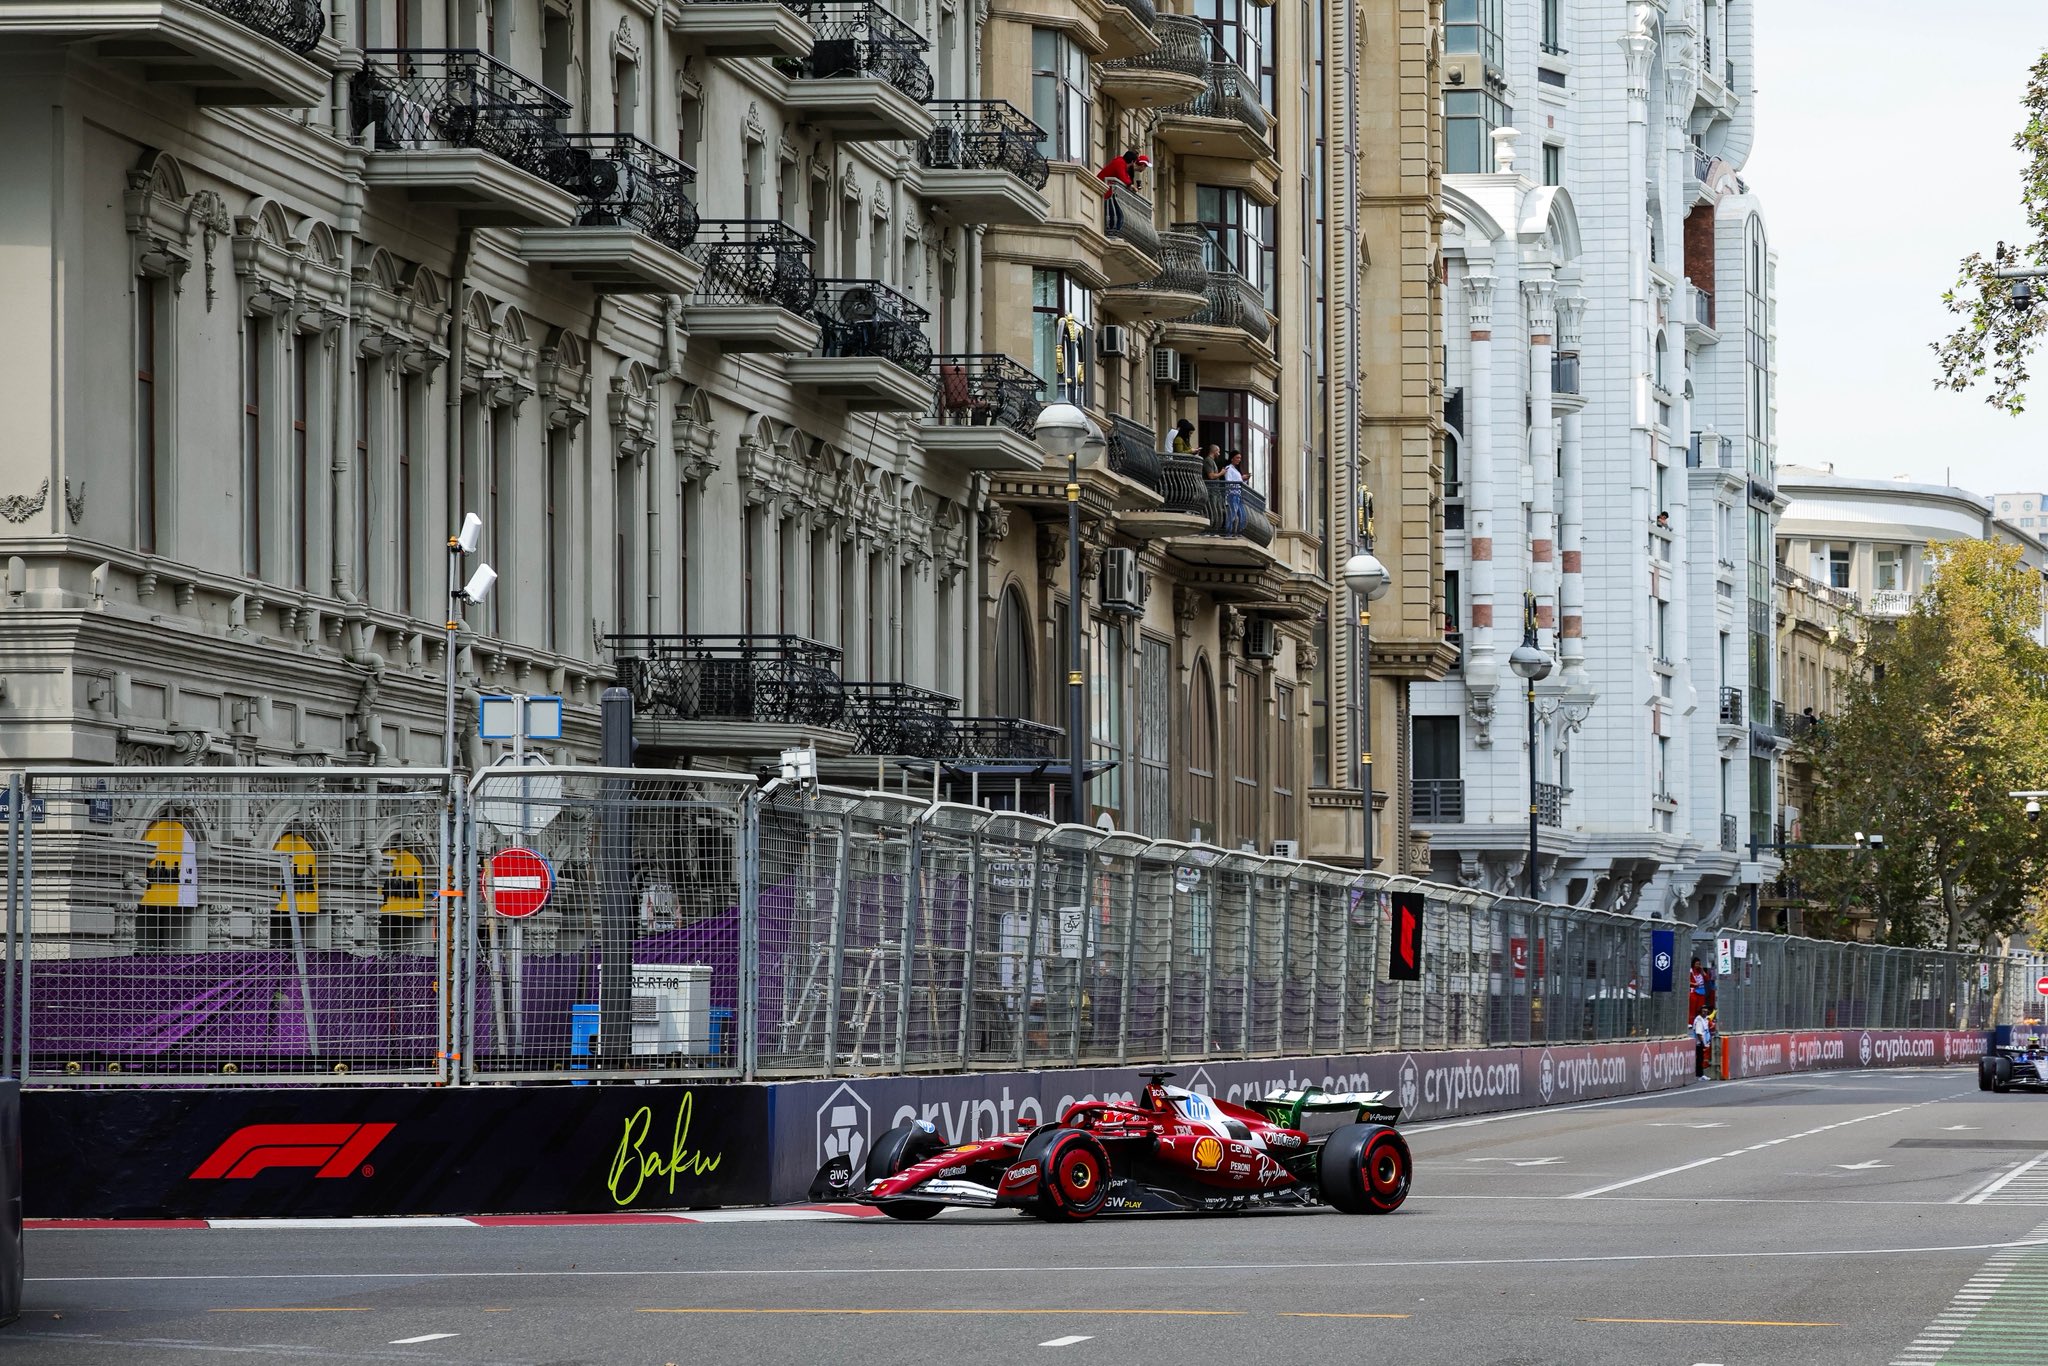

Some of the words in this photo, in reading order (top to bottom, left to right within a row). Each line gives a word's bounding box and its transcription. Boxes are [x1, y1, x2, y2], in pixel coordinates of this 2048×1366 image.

[1798, 1037, 1844, 1066] crypto.com
[1875, 1035, 1935, 1062] crypto.com
[1425, 1058, 1520, 1110] crypto.com
[1557, 1052, 1627, 1095] crypto.com
[1187, 1093, 1210, 1121] hp
[1369, 1113, 1396, 1122] V-Power
[608, 1091, 722, 1205] Baku
[829, 1169, 849, 1180] aws
[1230, 1161, 1251, 1172] PERONI
[1124, 1201, 1143, 1209] PLAY
